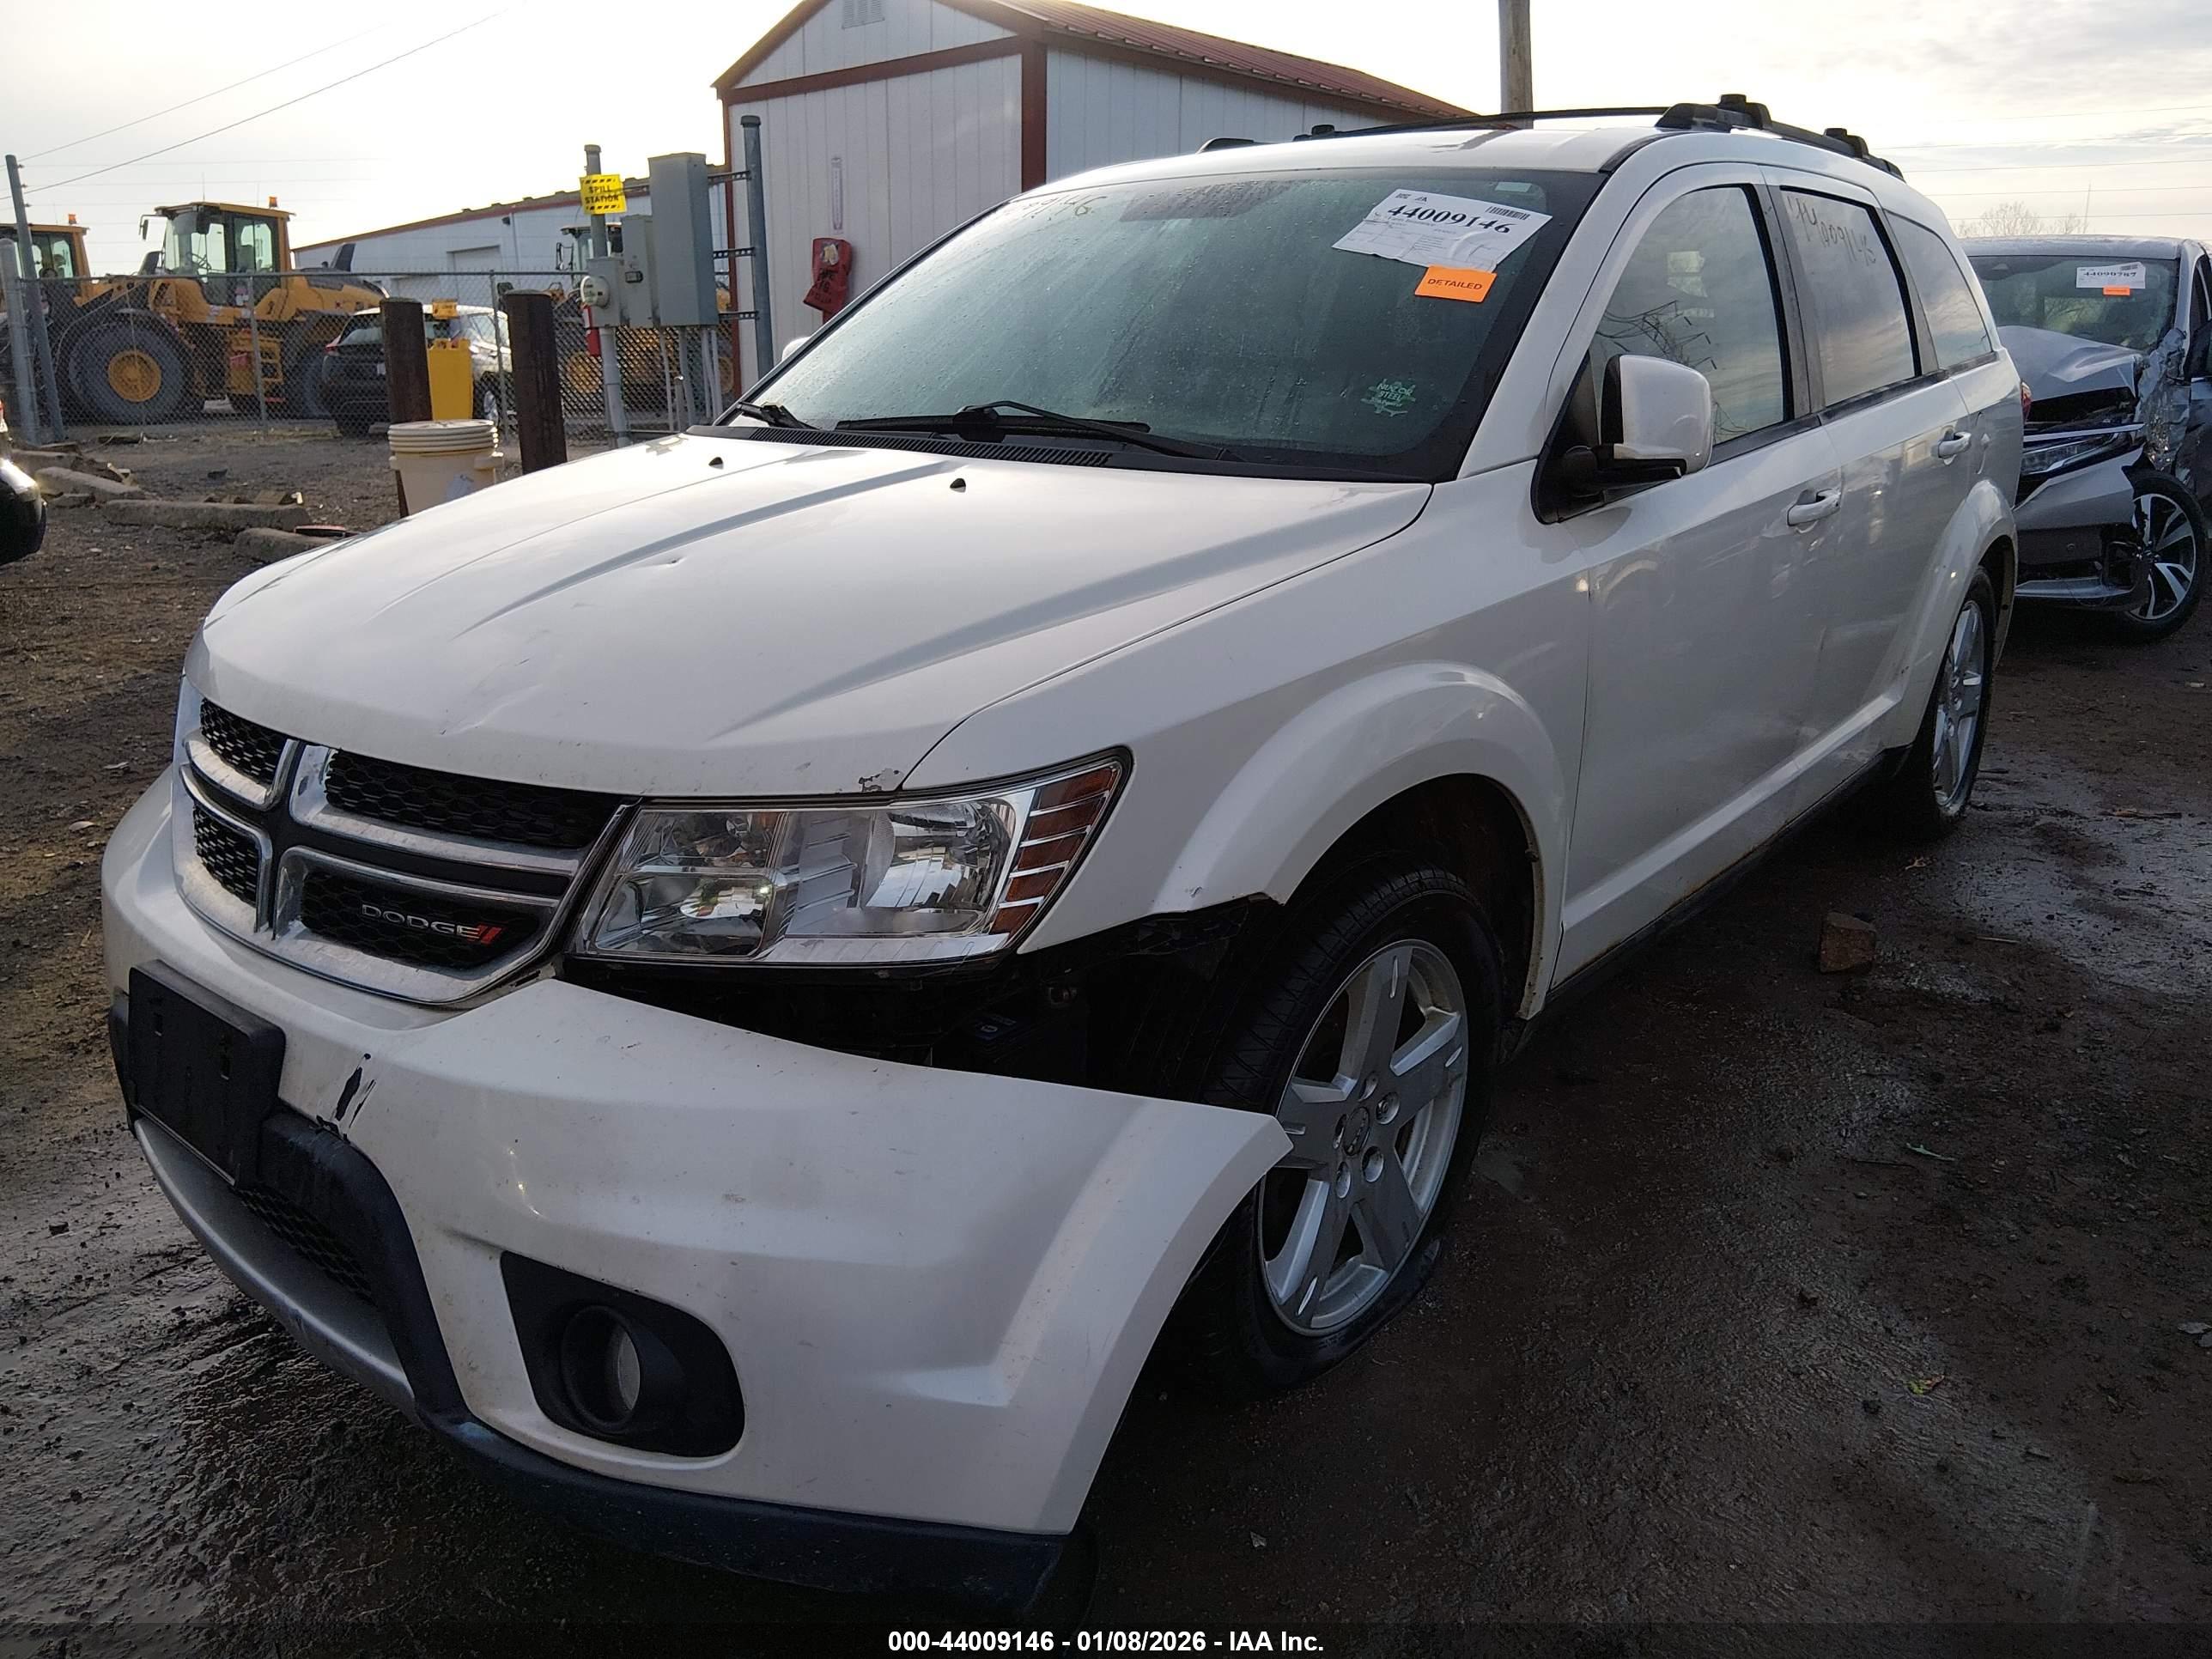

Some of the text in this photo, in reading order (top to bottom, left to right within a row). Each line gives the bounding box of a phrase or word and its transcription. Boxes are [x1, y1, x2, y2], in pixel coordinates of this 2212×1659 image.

[585, 194, 619, 204] STATION
[1388, 204, 1517, 234] 44009146
[1427, 278, 1483, 290] DETAILED
[362, 904, 480, 939] DODGE
